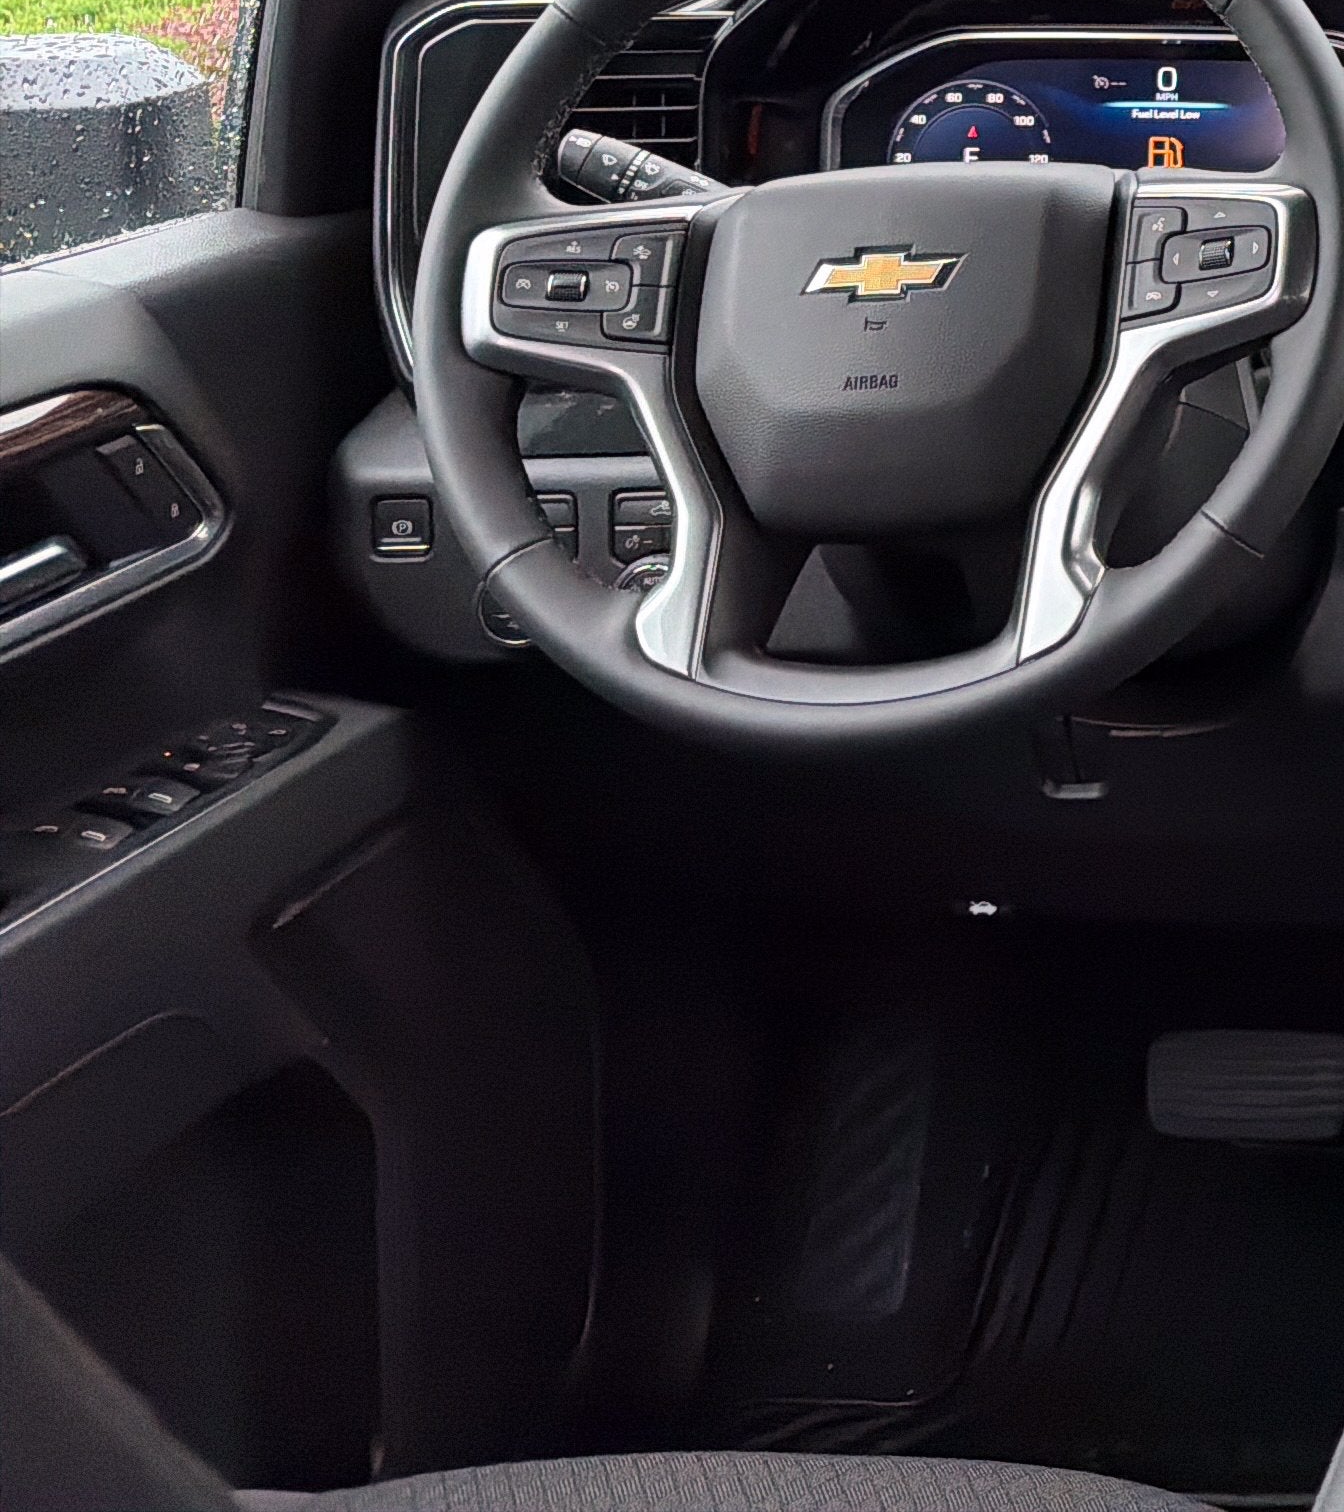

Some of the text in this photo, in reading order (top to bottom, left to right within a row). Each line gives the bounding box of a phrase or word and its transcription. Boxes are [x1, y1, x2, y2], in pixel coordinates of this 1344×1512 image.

[1156, 66, 1178, 92] 0
[945, 92, 963, 103] 60
[986, 93, 1004, 103] 80
[1155, 92, 1178, 101] MPH
[1131, 108, 1201, 119] Fuel Level Low
[909, 114, 927, 125] 40
[1012, 115, 1035, 126] 100
[894, 152, 911, 163] 20
[1029, 154, 1048, 164] 120
[842, 374, 899, 392] AIRBAG
